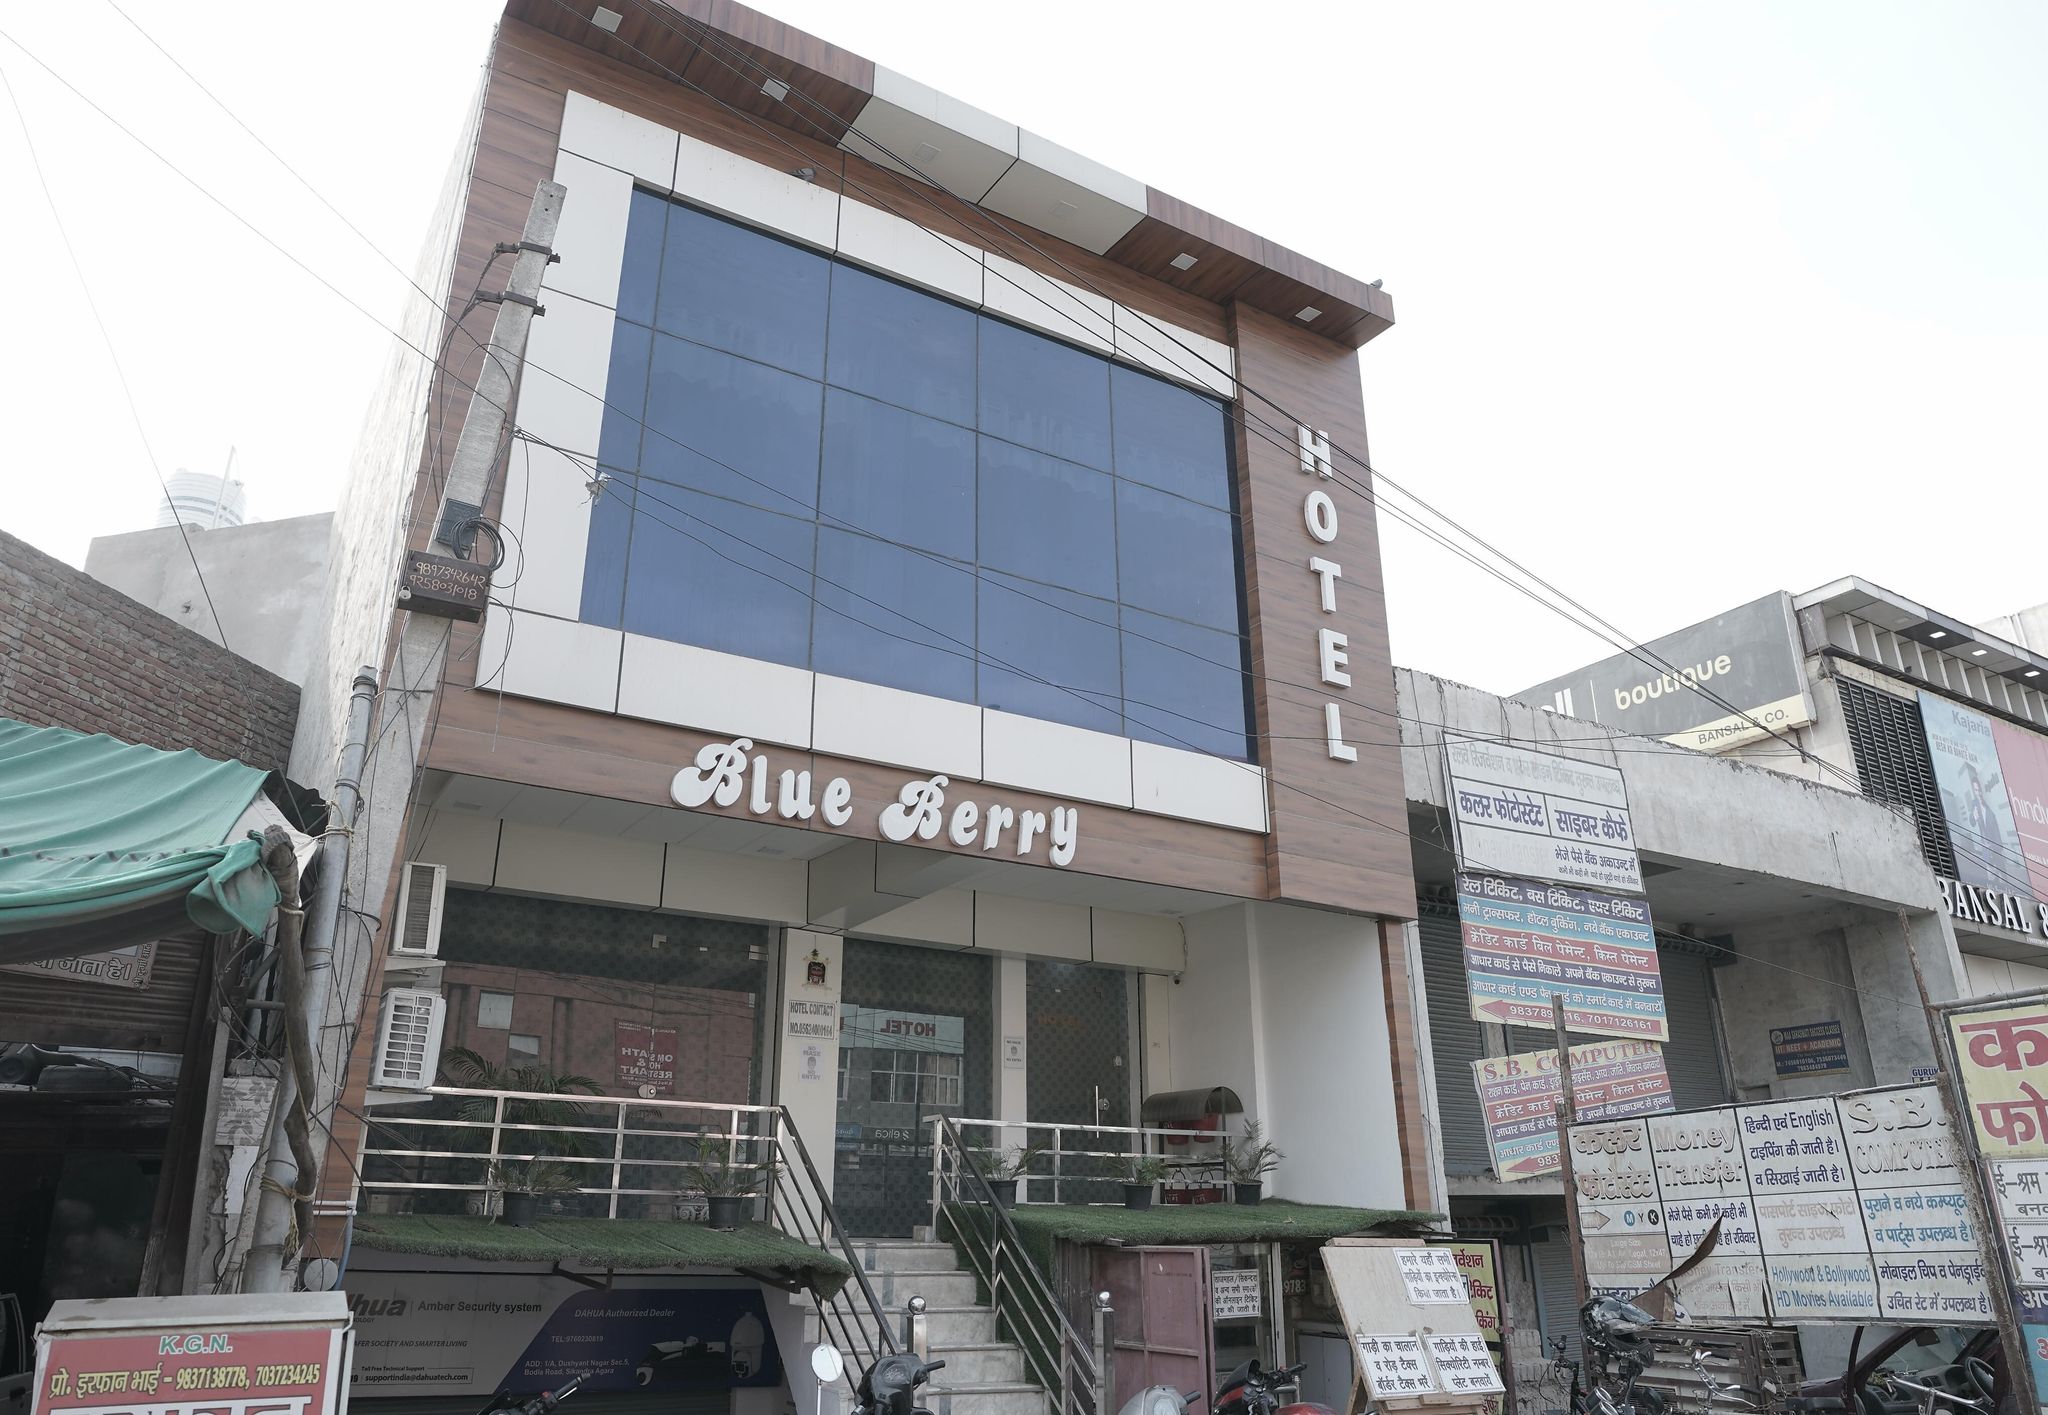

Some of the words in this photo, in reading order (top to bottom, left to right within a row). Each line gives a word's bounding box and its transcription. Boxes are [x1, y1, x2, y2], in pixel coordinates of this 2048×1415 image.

[416, 562, 485, 589] 9897342642
[410, 575, 477, 600] 9258031018
[1297, 424, 1357, 762] HOTEL
[1614, 654, 1732, 710] boutique
[1698, 718, 1749, 745] BANSAL
[1764, 708, 1789, 723] CO.
[1952, 710, 1991, 738] Kajaria
[670, 737, 853, 827] Blue
[878, 774, 1078, 867] Berry
[1459, 790, 1492, 819] कलर
[1493, 790, 1544, 827] फोटोस्टेट
[1554, 809, 1599, 838] साइबर
[1600, 810, 1628, 841] कैफे
[1462, 875, 1480, 893] रेल
[1939, 877, 2031, 933] BANSAL
[1503, 933, 1527, 951] कार्ड
[1470, 954, 1493, 968] आधार
[1493, 956, 1510, 971] कार्ड
[1472, 979, 1496, 994] आधार
[1498, 981, 1517, 996] कार्ड
[790, 1002, 808, 1014] HOTEL
[809, 1003, 833, 1016] CONTACT
[1588, 1014, 1652, 1030] 7017126161
[1484, 1059, 1528, 1081] S.B.
[1528, 1099, 1550, 1114] कार्ड
[1848, 1098, 1947, 1134] S.B.
[1496, 1122, 1519, 1138] आधार
[1519, 1119, 1536, 1133] कार्ड
[1745, 1112, 1771, 1134] हिन्दी
[1773, 1112, 1788, 1131] एवं
[1789, 1108, 1834, 1132] English
[1573, 1128, 1642, 1155] कलर
[1655, 1125, 1737, 1154] Money
[1750, 1140, 1784, 1160] टाइपिंग
[1785, 1139, 1799, 1157] की
[1800, 1140, 1825, 1156] जाती
[1657, 1157, 1743, 1187] Transfer
[1755, 1173, 1764, 1186] व
[1764, 1165, 1800, 1186] सिखाई
[1802, 1167, 1828, 1184] जाती
[1864, 1193, 1893, 1219] पुराने
[1894, 1198, 1902, 1210] व
[1905, 1192, 1924, 1211] नये
[1876, 1228, 1884, 1241] व
[1771, 1266, 1815, 1286] Hollywood
[1817, 1265, 1824, 1275] &
[1825, 1265, 1871, 1284] Bollywood
[1879, 1261, 1917, 1280] मोबाइल
[1918, 1259, 1937, 1280] चिप
[1938, 1267, 1946, 1279] व
[418, 1300, 454, 1312] Amber
[457, 1300, 502, 1315] Security
[504, 1301, 542, 1314] system
[1775, 1291, 1790, 1308] HD
[1792, 1291, 1825, 1308] Movies
[1828, 1290, 1874, 1308] Available
[1887, 1291, 1912, 1310] उचित
[1915, 1292, 1928, 1311] रेट
[574, 1309, 604, 1318] DAHUA
[606, 1309, 649, 1318] Authorized
[649, 1308, 675, 1317] Dealer
[159, 1335, 233, 1355] K.G.N.
[49, 1367, 71, 1399] प्रो.
[76, 1371, 130, 1399] इरफान
[130, 1362, 164, 1395] भाई
[175, 1366, 250, 1391] 9837138778,
[255, 1364, 320, 1387] 7037234245
[365, 1372, 469, 1383] supportindia@dahuatech.com
